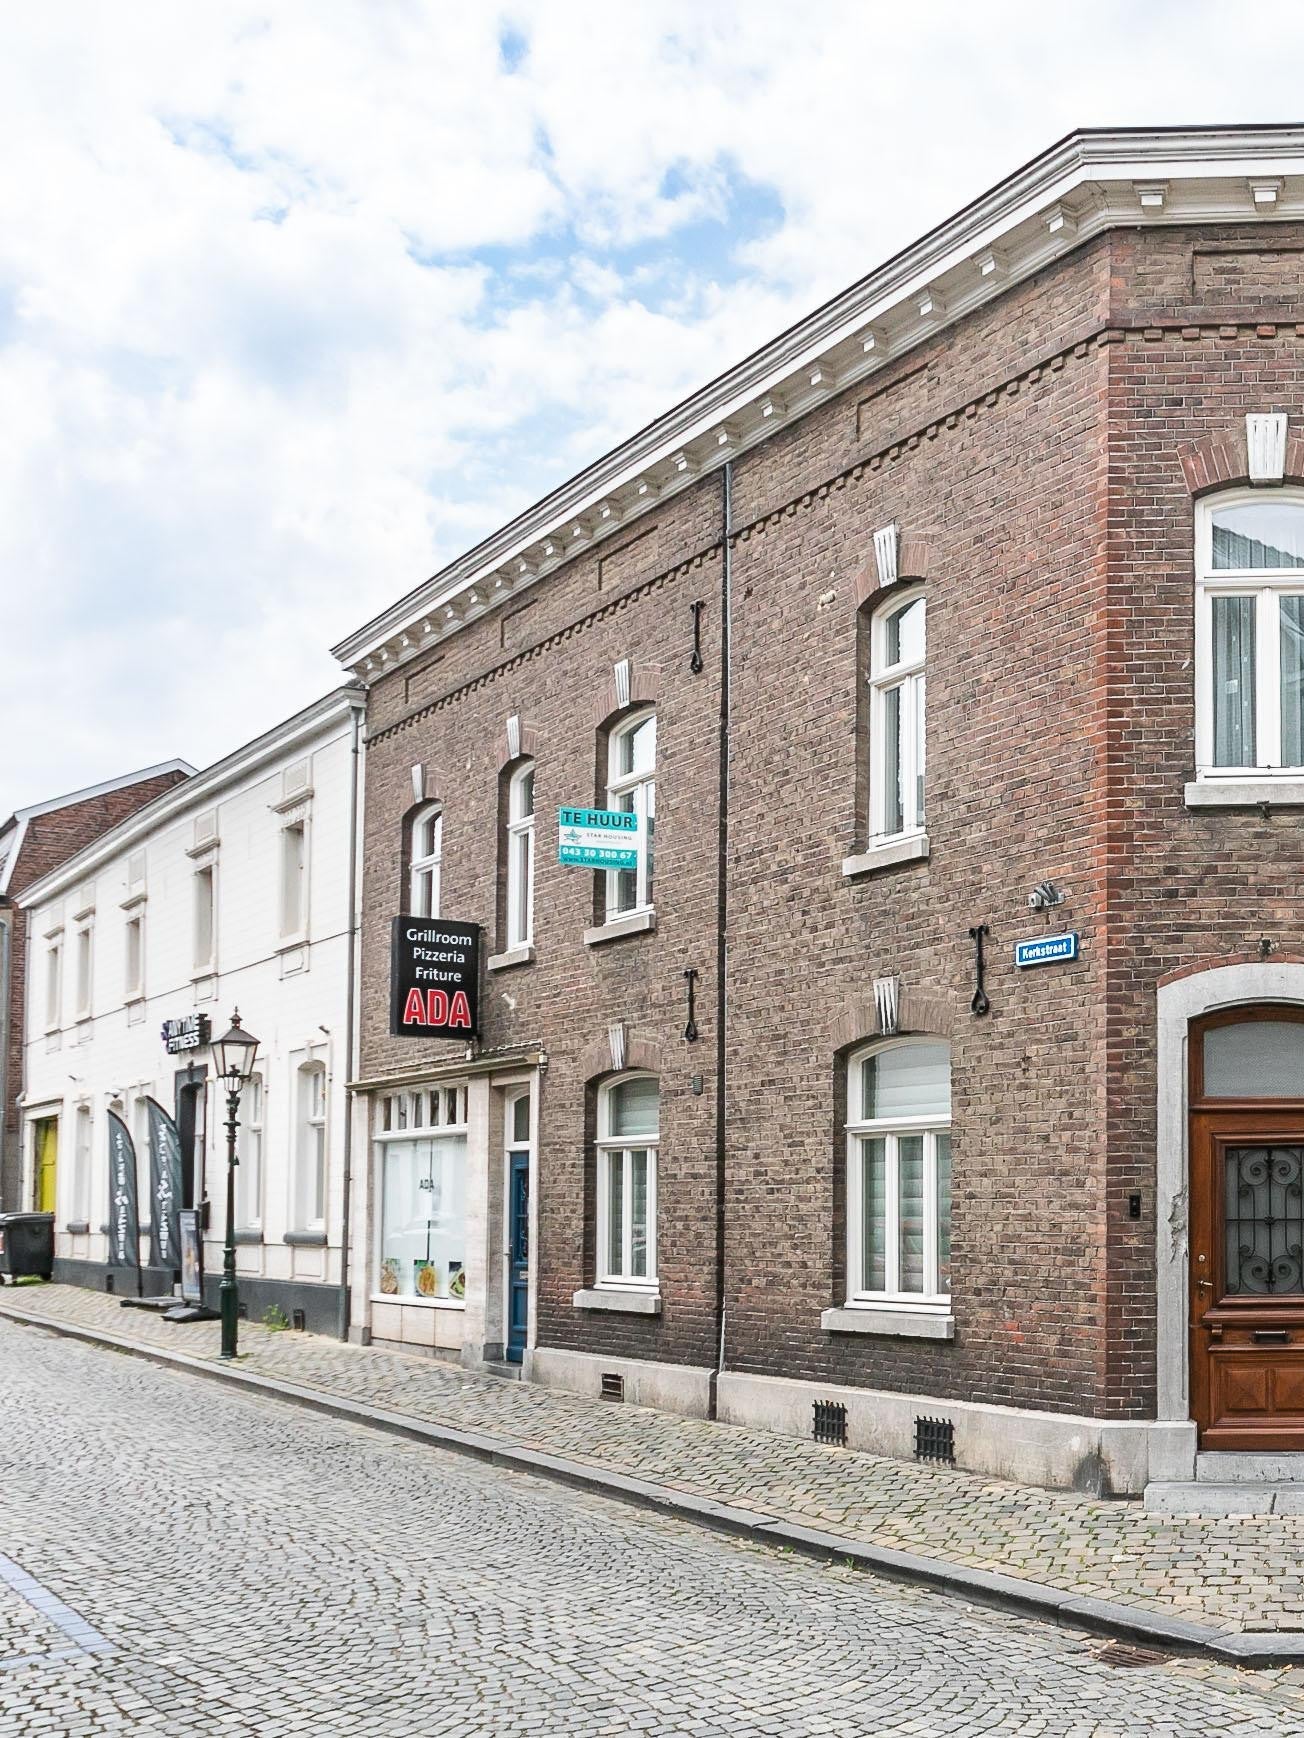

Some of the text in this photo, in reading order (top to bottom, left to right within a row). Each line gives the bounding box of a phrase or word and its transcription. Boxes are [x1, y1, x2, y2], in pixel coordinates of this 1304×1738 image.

[562, 811, 633, 828] TE HUUR
[562, 847, 581, 856] 043
[620, 851, 632, 860] 67
[406, 928, 472, 946] Grillroom
[413, 947, 465, 963] Pizzeria
[1022, 941, 1067, 959] Kerkstraat
[415, 966, 462, 982] Friture
[403, 987, 472, 1028] ADA
[168, 1031, 200, 1052] FITNESS
[419, 1178, 435, 1190] ADA
